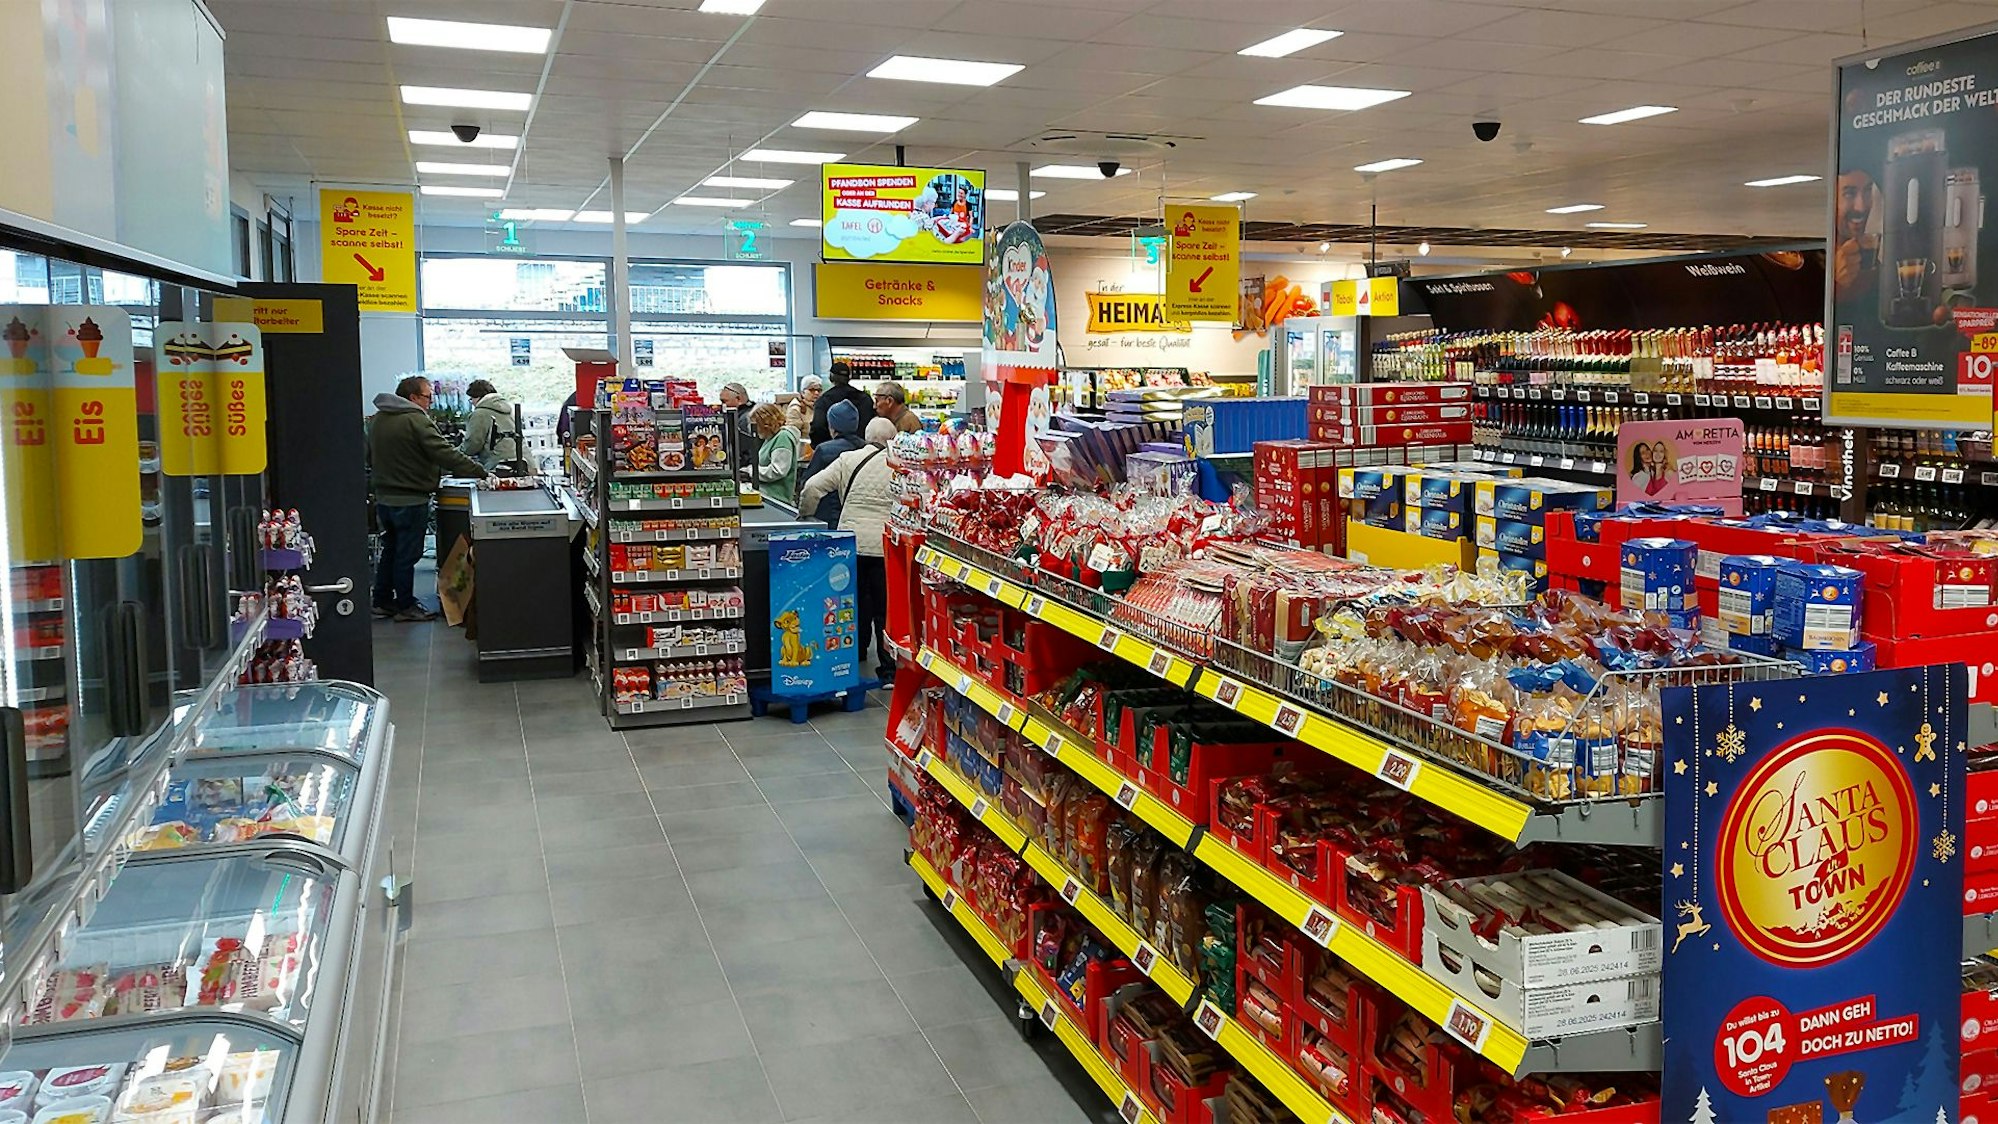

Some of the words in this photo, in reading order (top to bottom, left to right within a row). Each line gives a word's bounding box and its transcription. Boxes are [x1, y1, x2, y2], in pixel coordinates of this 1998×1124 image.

[1876, 90, 1902, 107] DER
[1904, 75, 1975, 102] RUNDESTE
[1853, 101, 1930, 129] GESCHMACK
[1933, 96, 1960, 114] DER
[877, 177, 913, 187] SPENDEN
[836, 200, 862, 208] KASSE
[863, 200, 911, 209] AUFRUNDEN
[336, 227, 366, 237] Spare
[369, 228, 388, 237] Zeit
[503, 222, 519, 244] 1
[842, 221, 862, 230] TAFEL
[330, 239, 367, 248] scanne
[370, 240, 403, 248] selbst!
[742, 230, 757, 252] 2
[1176, 241, 1200, 250] Spare
[1147, 246, 1158, 264] 3
[1203, 253, 1230, 261] selbst!
[1007, 258, 1027, 272] kinder
[1685, 262, 1746, 278] Weißwein
[865, 278, 922, 292] Getränke
[927, 281, 935, 291] &
[878, 294, 923, 306] Snacks
[1098, 302, 1166, 323] HEIMA
[1886, 348, 1909, 358] Coffee
[1911, 348, 1917, 358] B
[1886, 362, 1944, 372] Kaffeemaschine
[1885, 376, 1911, 385] schwarz
[1912, 376, 1927, 384] oder
[229, 380, 246, 436] Süßes
[74, 400, 104, 444] Eis
[1841, 428, 1854, 501] Vinothek
[781, 674, 813, 688] Disney
[1745, 770, 1882, 862] SANTA
[1762, 808, 1889, 879] CLAUS
[1788, 864, 1866, 910] TOWN
[1601, 961, 1628, 971] 242414
[1600, 1011, 1626, 1020] 242414
[1726, 1020, 1737, 1031] Du
[1738, 1014, 1757, 1028] willst
[1758, 1012, 1769, 1022] bis
[1769, 1009, 1780, 1018] zu
[1800, 1012, 1840, 1033] DANN
[1842, 1002, 1871, 1022] GEH
[1458, 1015, 1477, 1037] 1.19
[1802, 1035, 1842, 1054] DOCH
[1845, 1031, 1863, 1046] ZU
[1866, 1020, 1913, 1042] NETTO!
[1723, 1023, 1786, 1068] 104
[1738, 1066, 1757, 1079] Santa
[1758, 1062, 1777, 1074] Claus
[1750, 1081, 1771, 1093] Artikel
